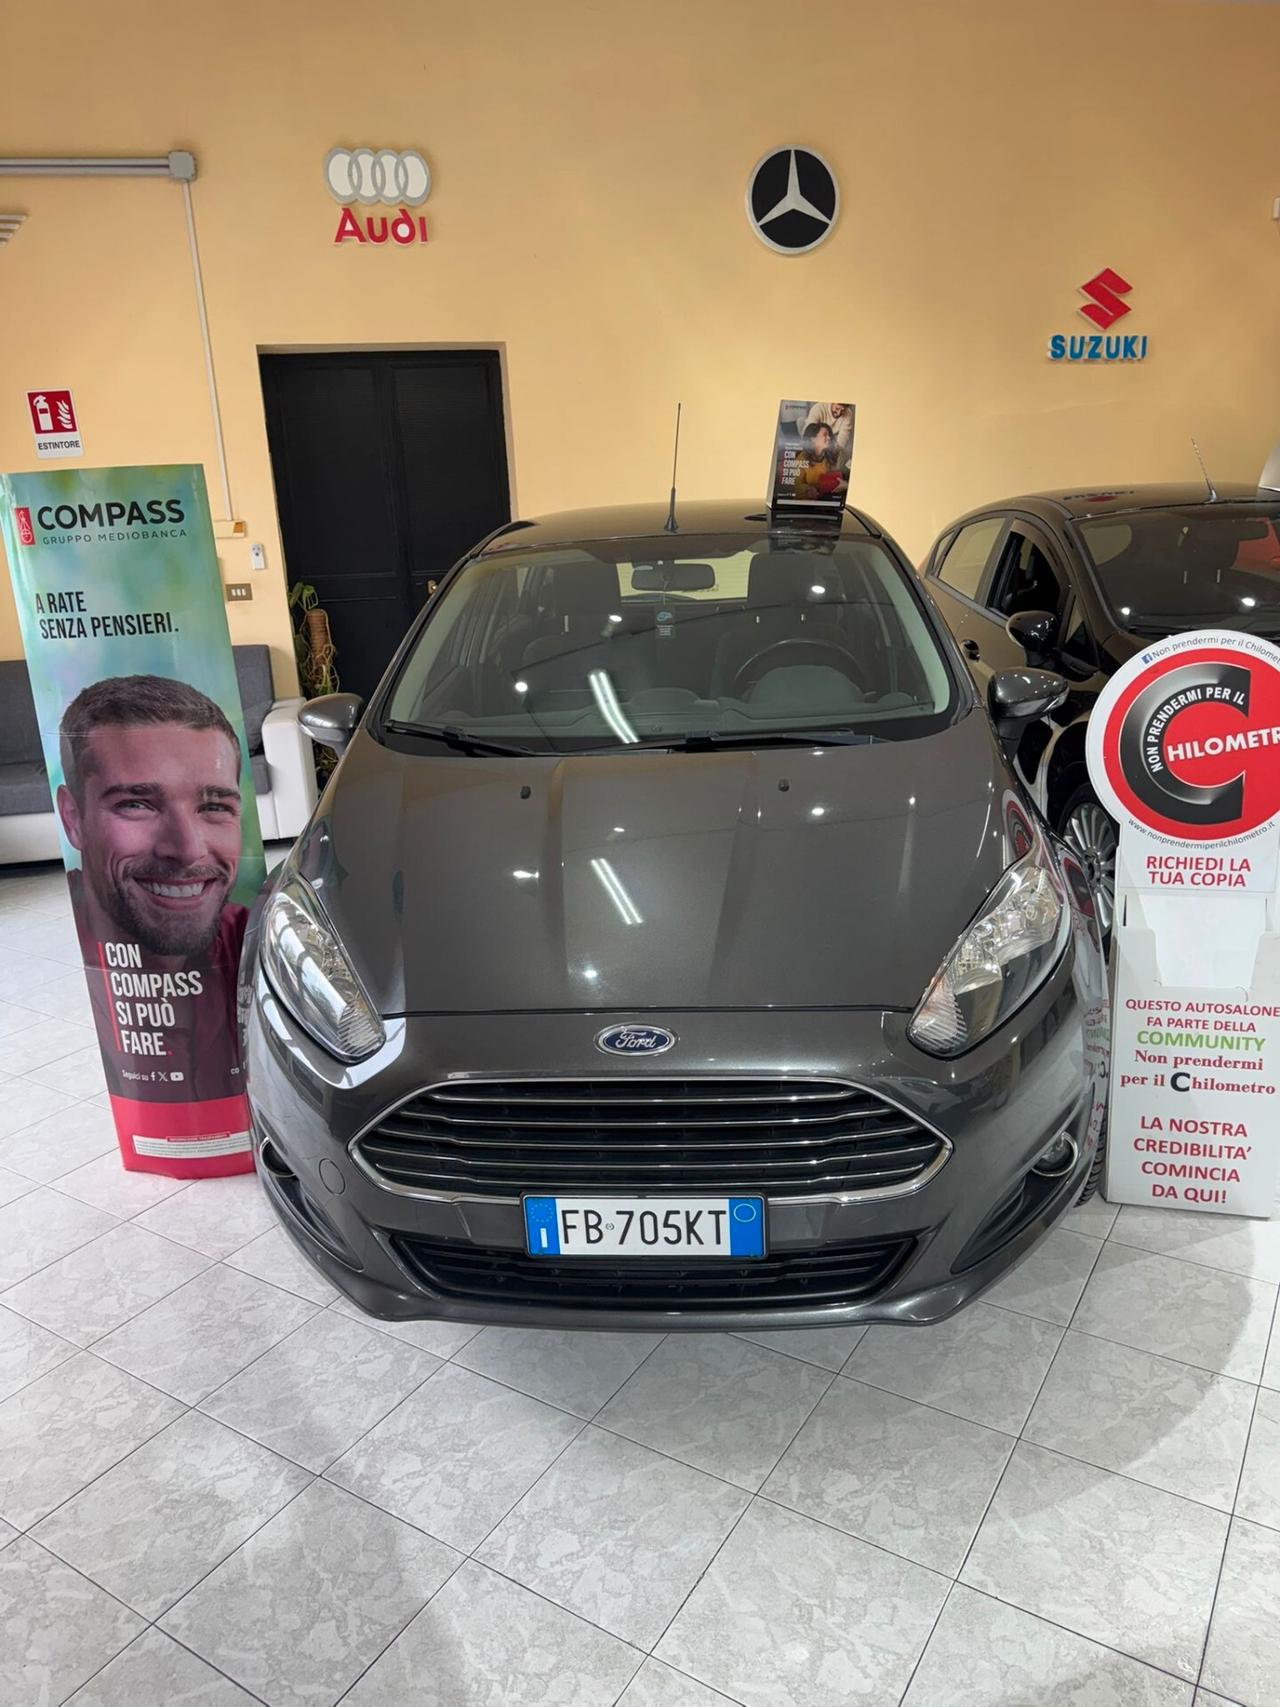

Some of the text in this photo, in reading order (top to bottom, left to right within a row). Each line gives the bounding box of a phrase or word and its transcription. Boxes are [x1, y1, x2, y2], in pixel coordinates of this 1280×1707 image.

[334, 207, 429, 245] Audi
[1048, 334, 1149, 361] SUZUKI
[37, 440, 81, 451] ESTINTORE
[783, 459, 810, 469] COMPASS
[37, 499, 186, 531] COMPASS
[42, 529, 187, 545] GRUPPO MEDIOBANCA
[35, 591, 87, 614] A RATE
[39, 612, 180, 640] SENZA PENSIERI.
[1151, 646, 1171, 660] Non
[1172, 637, 1219, 652] prendermi
[1220, 636, 1237, 646] per
[1237, 638, 1245, 647] il
[1146, 686, 1246, 773] NON PRENDERMI PER IL
[1146, 856, 1252, 872] RICHIEDI LA
[1148, 871, 1246, 887] TUA COPIA
[105, 942, 143, 968] CON
[110, 970, 204, 998] COMPASS
[115, 998, 176, 1027] SI PUÒ
[1125, 998, 1280, 1017] QUESTO AUTOSALONE
[1146, 1016, 1257, 1033] FA PARTE DELLA
[614, 1027, 657, 1049] Ford
[1136, 1030, 1266, 1051] COMMUNITY
[1134, 1050, 1264, 1071] Non prendermi
[1120, 1072, 1276, 1095] per il Chilometro
[1140, 1115, 1248, 1137] LA NOSTRA
[1141, 1161, 1241, 1183] COMINCIA
[1152, 1184, 1227, 1204] DA QUI!
[560, 1209, 604, 1245] FB
[615, 1210, 728, 1246] 705KT
